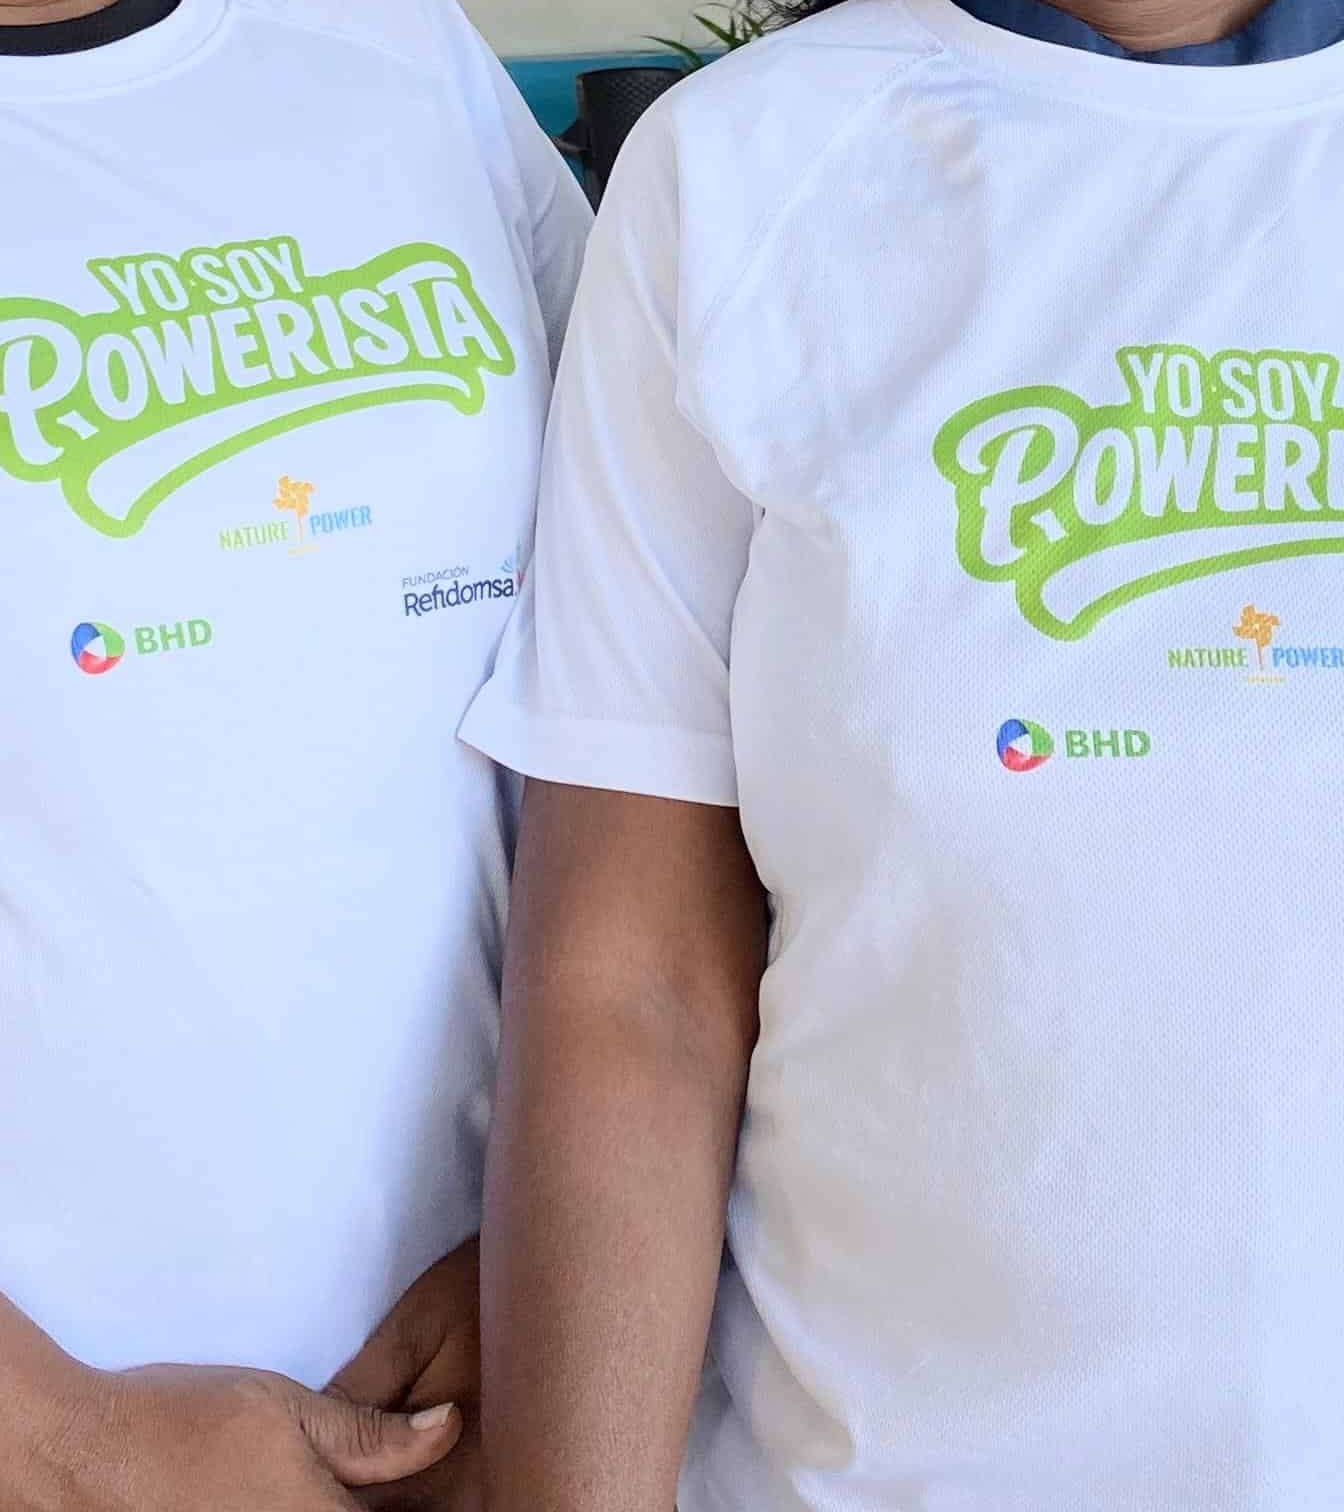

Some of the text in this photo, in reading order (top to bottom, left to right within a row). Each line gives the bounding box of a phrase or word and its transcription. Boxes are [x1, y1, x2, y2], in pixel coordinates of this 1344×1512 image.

[106, 243, 294, 316] YO SOY
[1126, 352, 1329, 420] YO SOY
[219, 505, 372, 551] NATURE POWER
[402, 564, 470, 589] FUNDACIÓN
[134, 619, 212, 656] BHD
[1167, 646, 1344, 669] NATURE POWER
[1064, 729, 1151, 758] BHD
